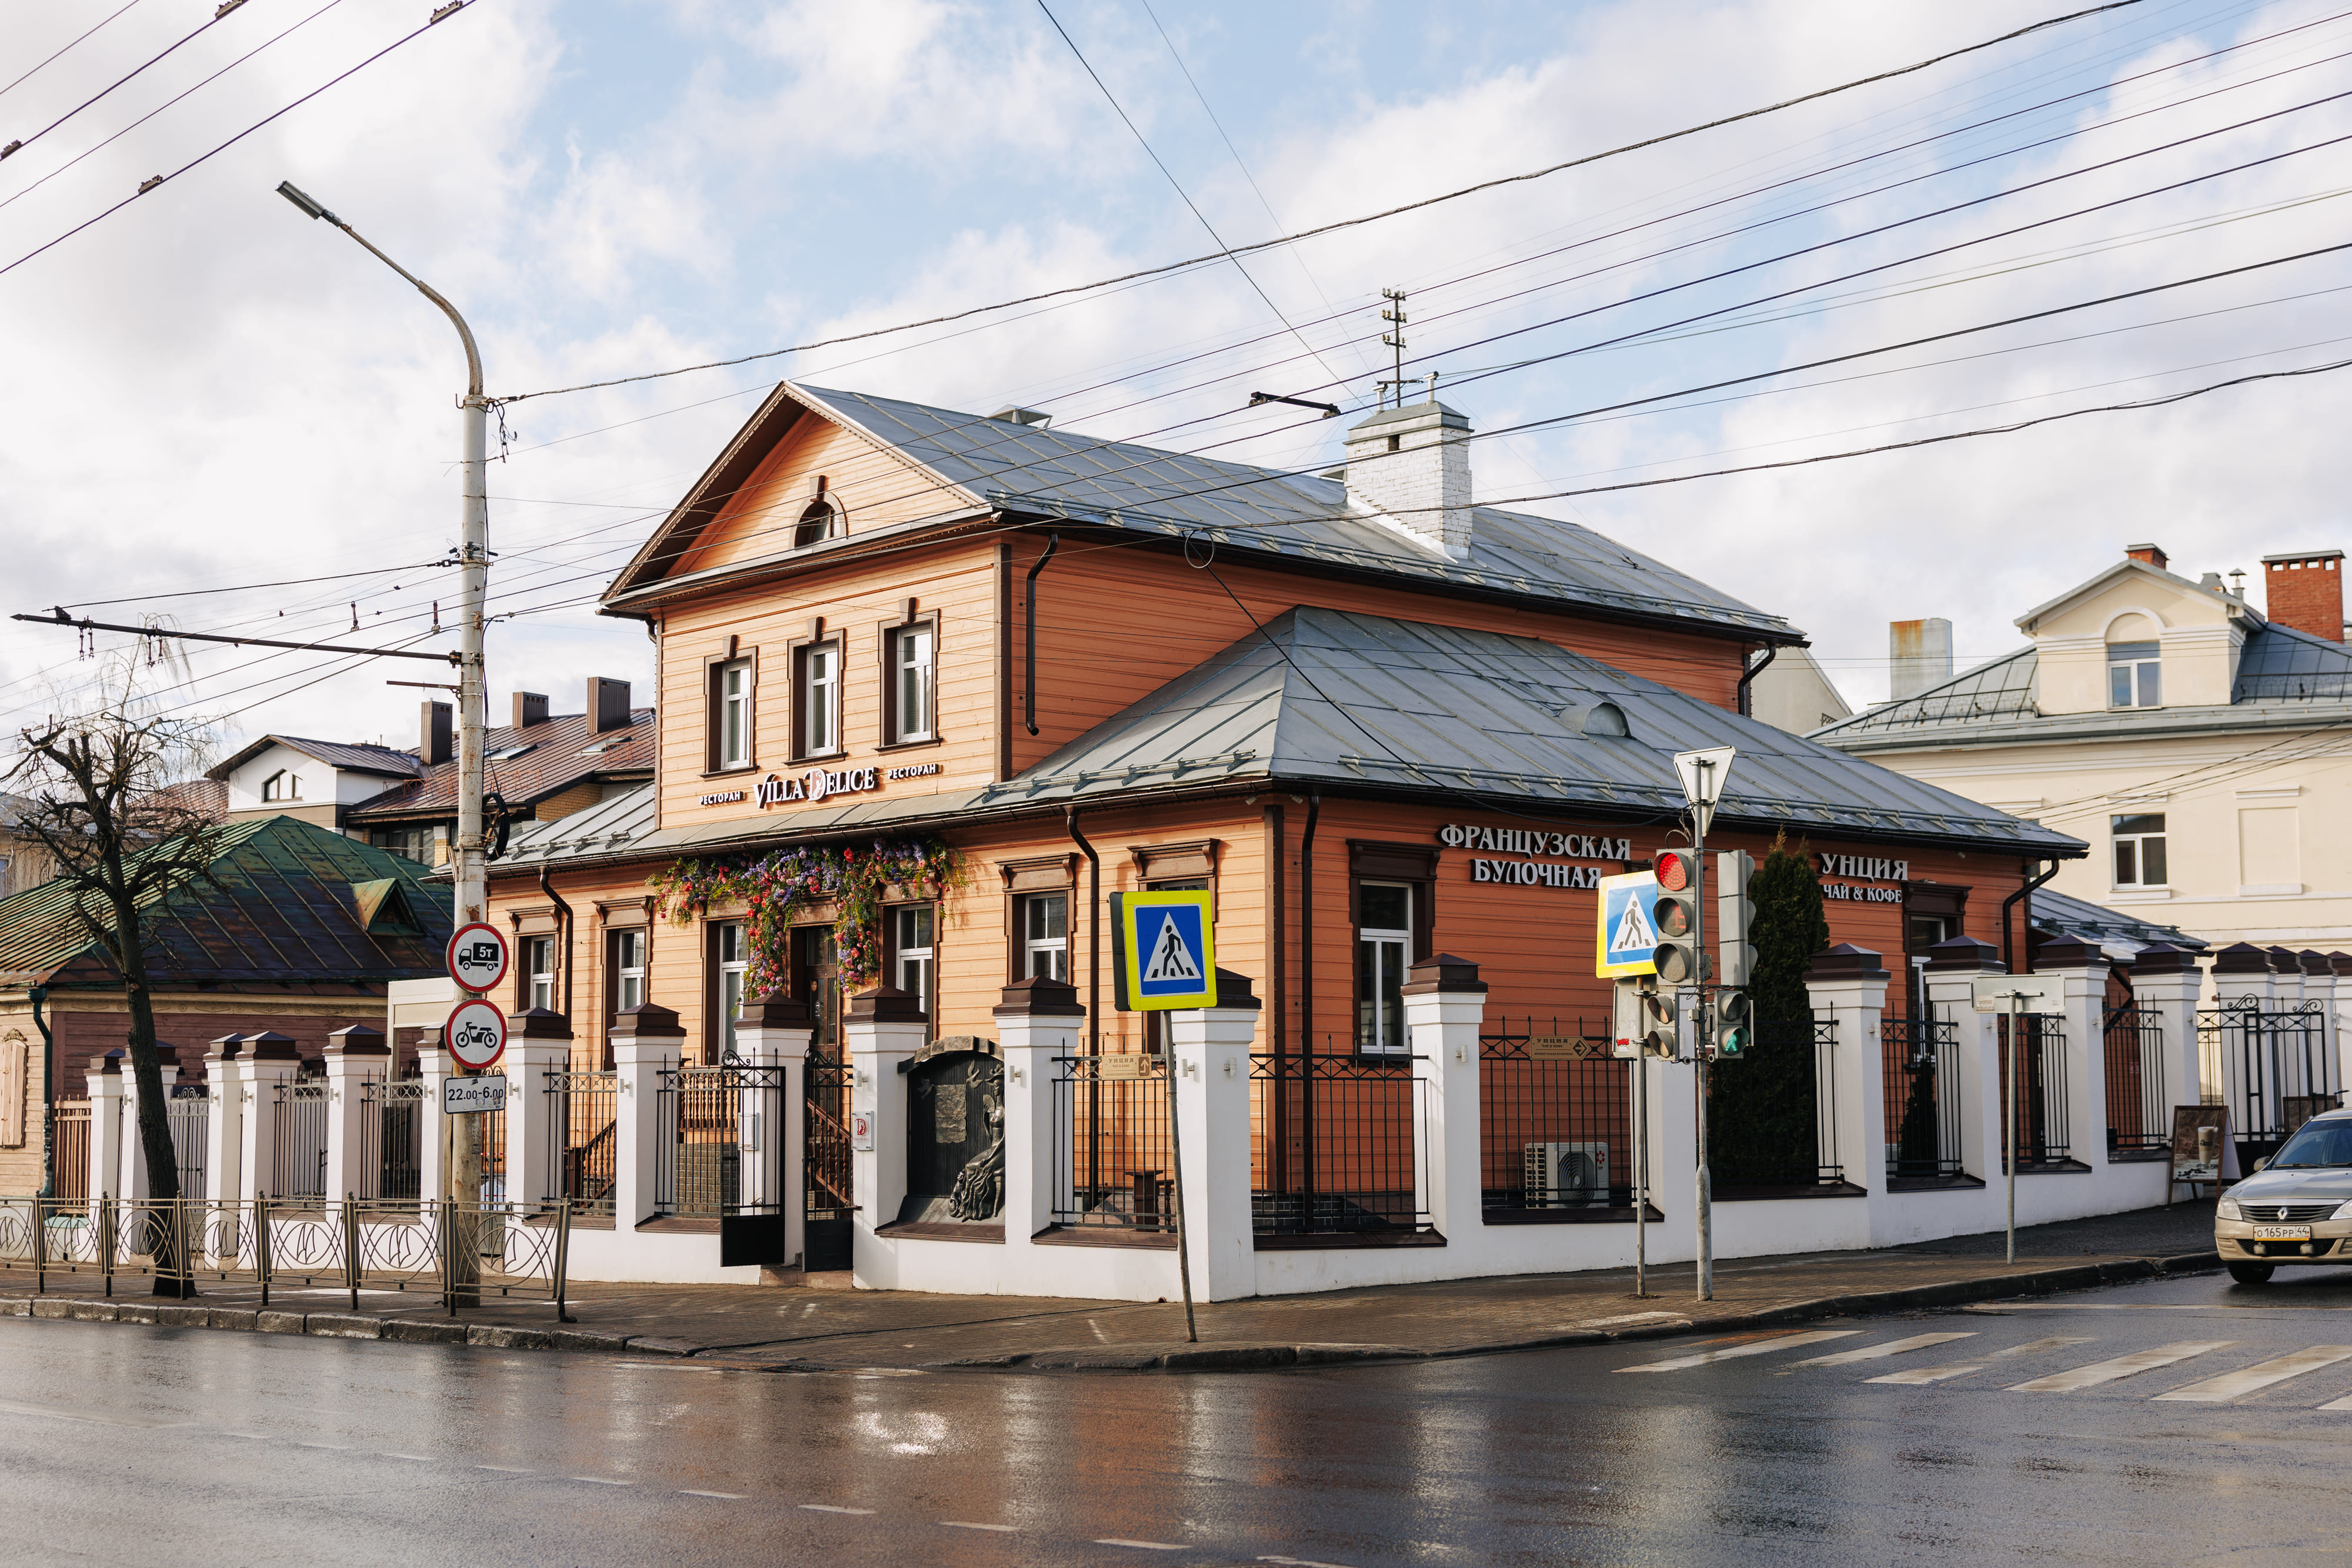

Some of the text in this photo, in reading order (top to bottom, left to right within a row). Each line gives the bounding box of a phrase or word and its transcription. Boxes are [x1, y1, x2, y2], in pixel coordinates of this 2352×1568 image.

[887, 763, 936, 780] РЕСТОРАН
[699, 791, 740, 805] РЕСТОРАН
[751, 767, 875, 809] VILLA DELICE
[1441, 824, 1632, 860] ФРАНЦУЗСКАЯ
[1474, 858, 1602, 888] БУЛОЧНАЯ
[1820, 852, 1909, 883] УНЦИЯ
[1823, 883, 1903, 903] ЧАЙ & КОФЕ
[448, 1086, 504, 1101] 22.00-6.00
